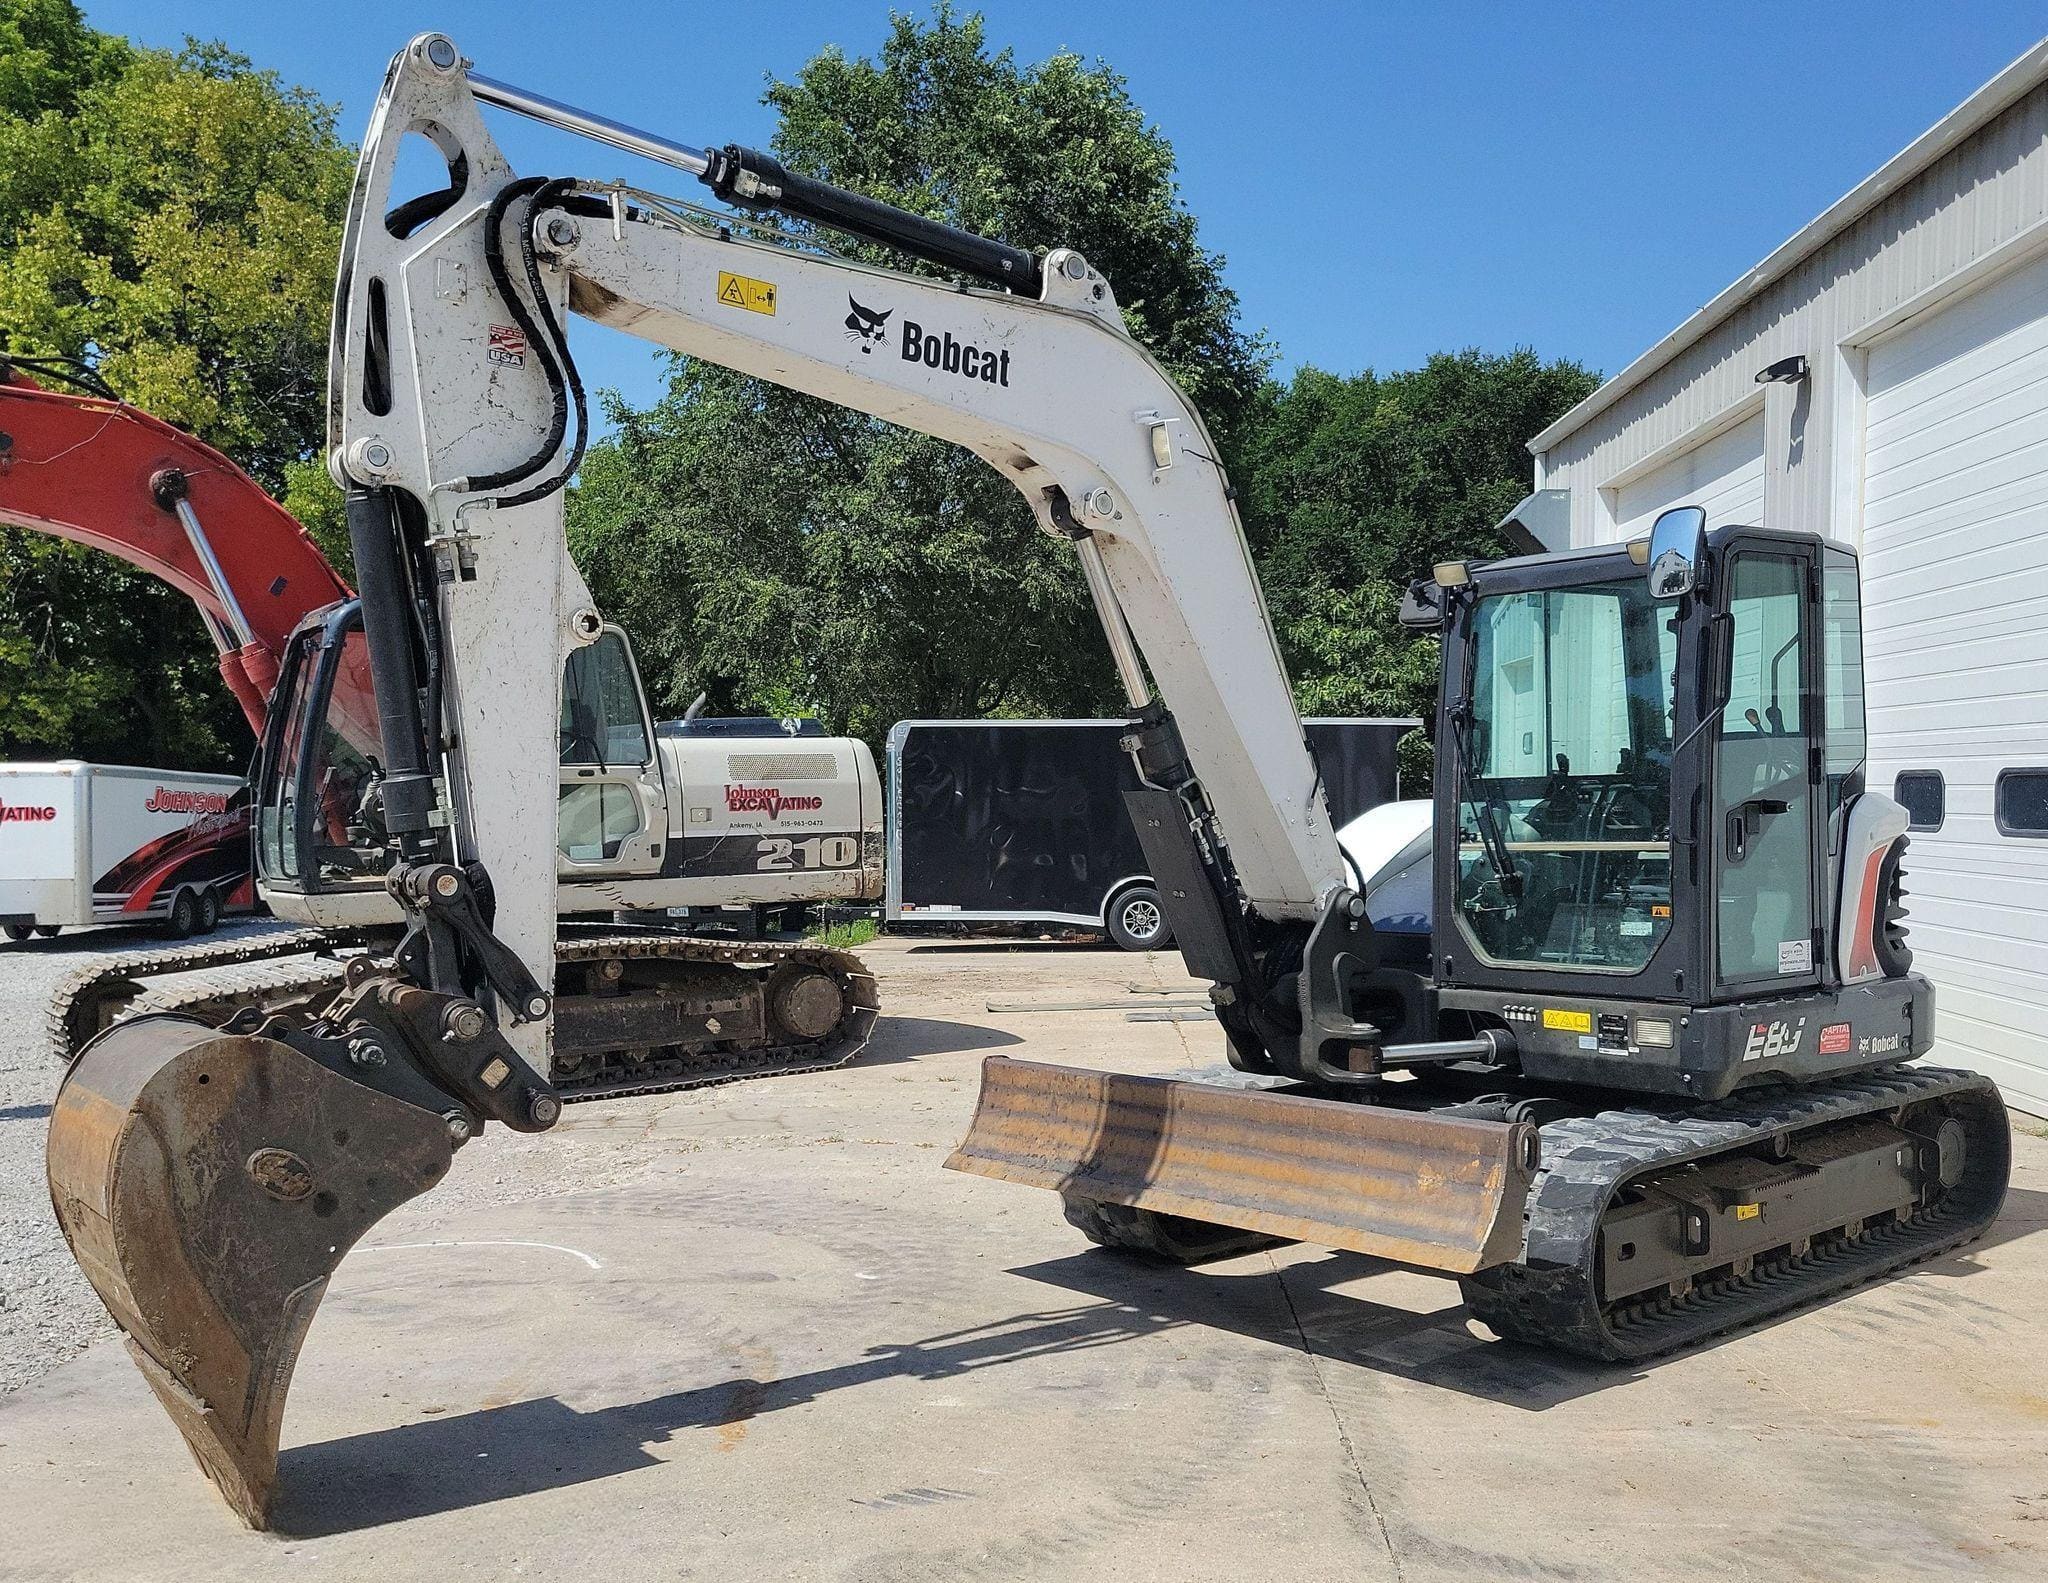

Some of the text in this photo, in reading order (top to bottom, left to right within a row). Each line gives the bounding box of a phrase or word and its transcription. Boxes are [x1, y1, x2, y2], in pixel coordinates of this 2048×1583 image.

[490, 350, 522, 366] USA
[901, 320, 1010, 388] Bobcat
[145, 786, 229, 814] JOHNSON
[724, 784, 780, 803] Johnson
[728, 796, 823, 821] EXCAVATING
[757, 837, 857, 870] 210
[1871, 1033, 1898, 1054] Bobcat
